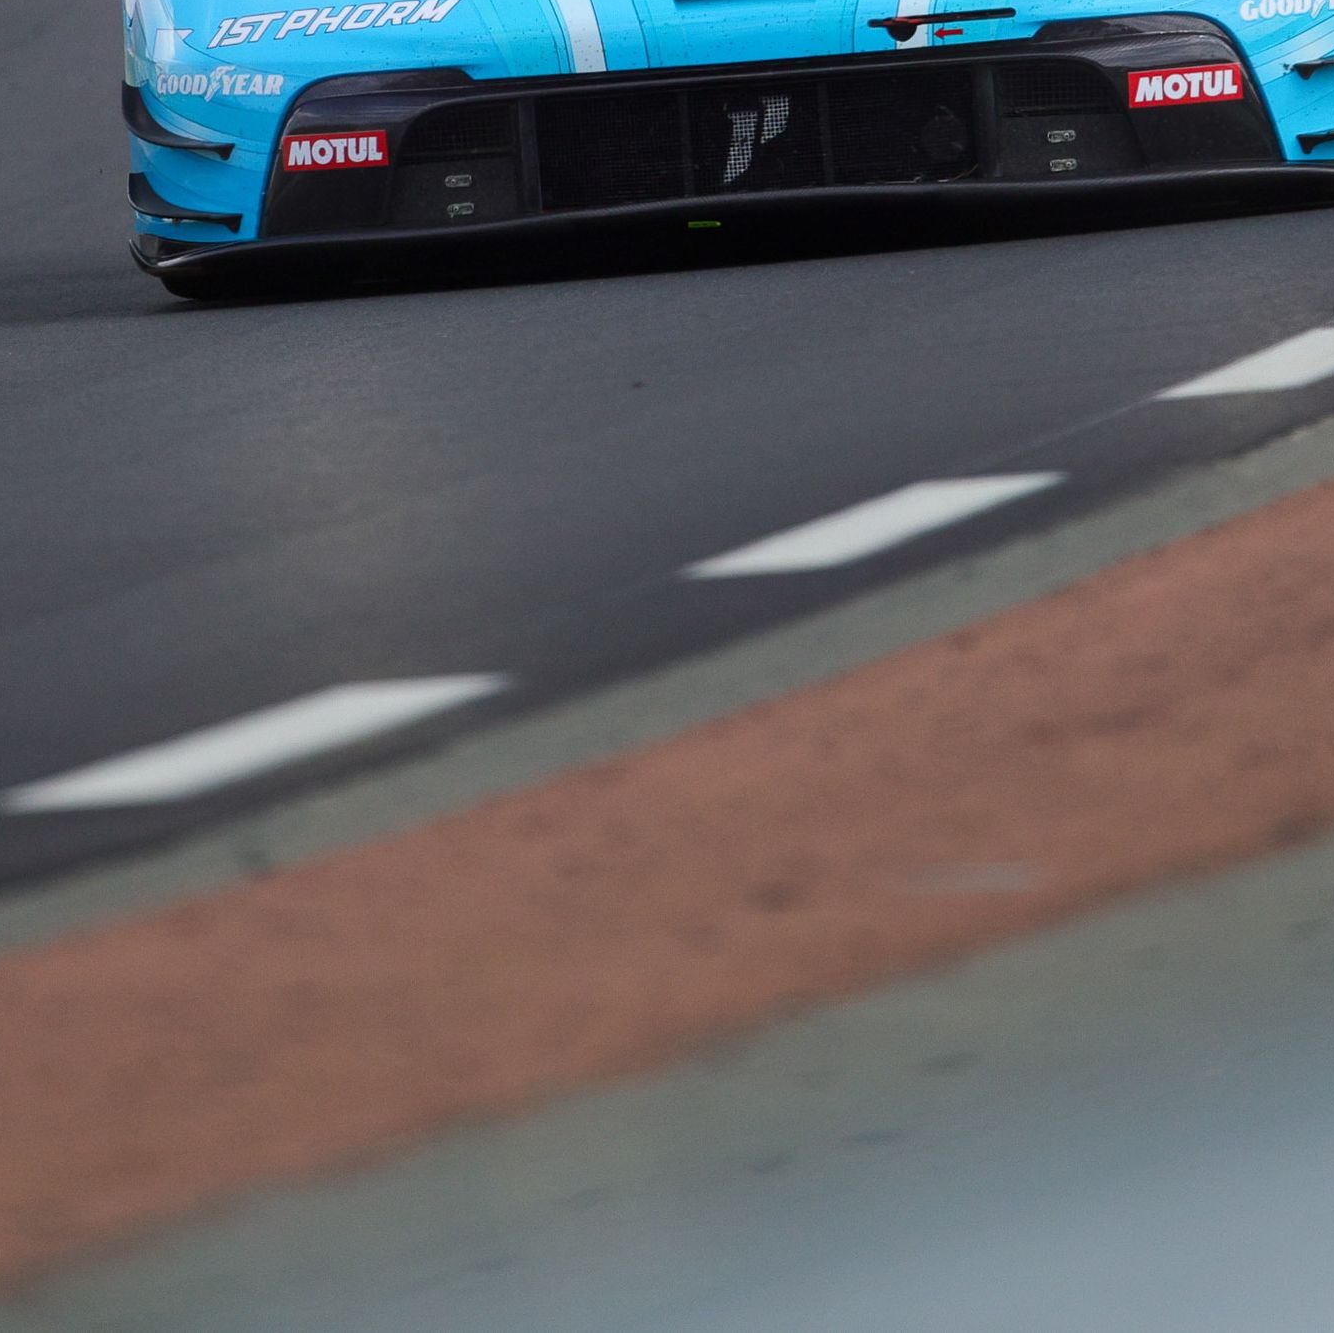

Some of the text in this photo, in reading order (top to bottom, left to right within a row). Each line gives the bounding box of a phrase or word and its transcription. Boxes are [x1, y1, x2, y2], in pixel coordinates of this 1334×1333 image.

[207, 11, 290, 49] 1ST
[1134, 69, 1239, 103] MOTUL
[287, 136, 383, 166] MOTUL
